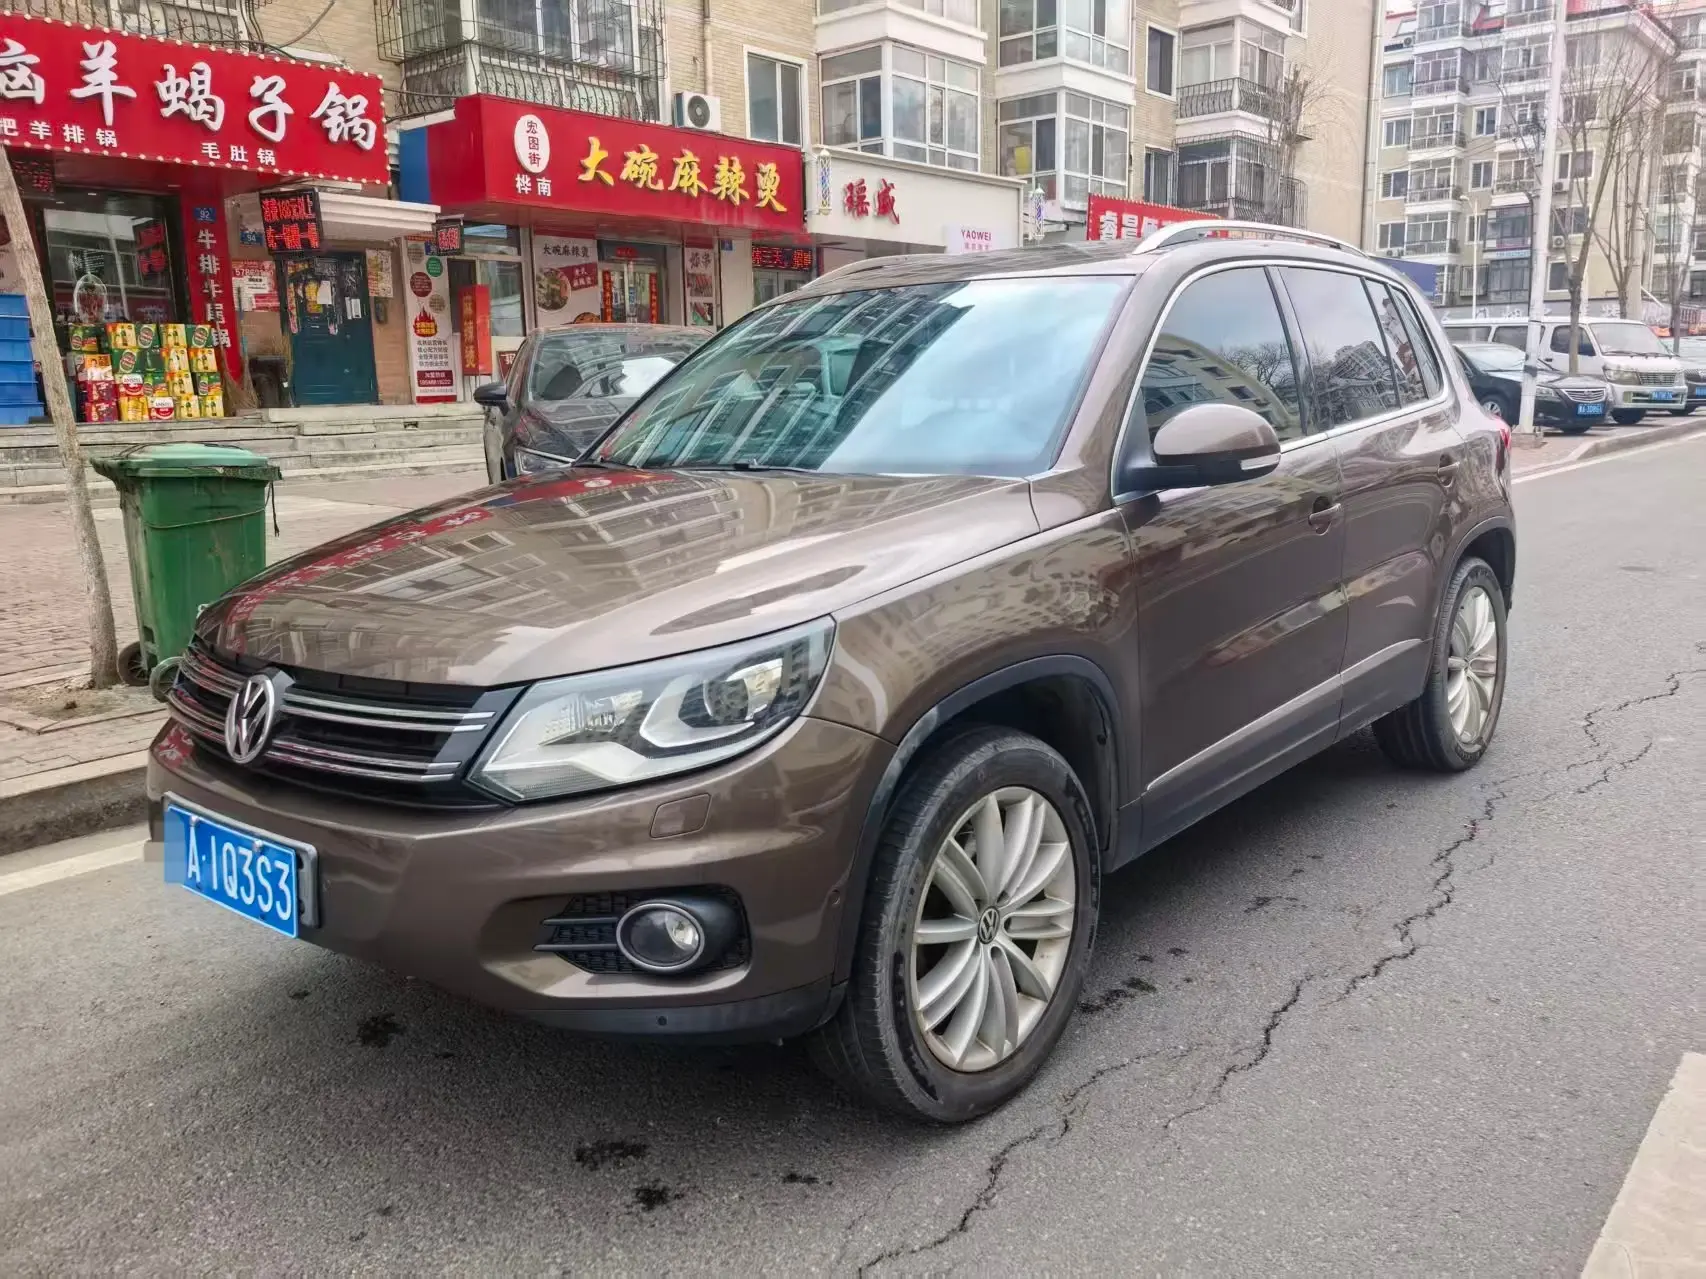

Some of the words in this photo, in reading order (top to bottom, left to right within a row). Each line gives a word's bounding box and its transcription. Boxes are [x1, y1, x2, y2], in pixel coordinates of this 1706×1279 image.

[201, 142, 276, 166] 毛肚锅
[526, 120, 541, 168] 宏图街
[515, 173, 552, 196] 桦南
[961, 229, 992, 241] YAOWEI
